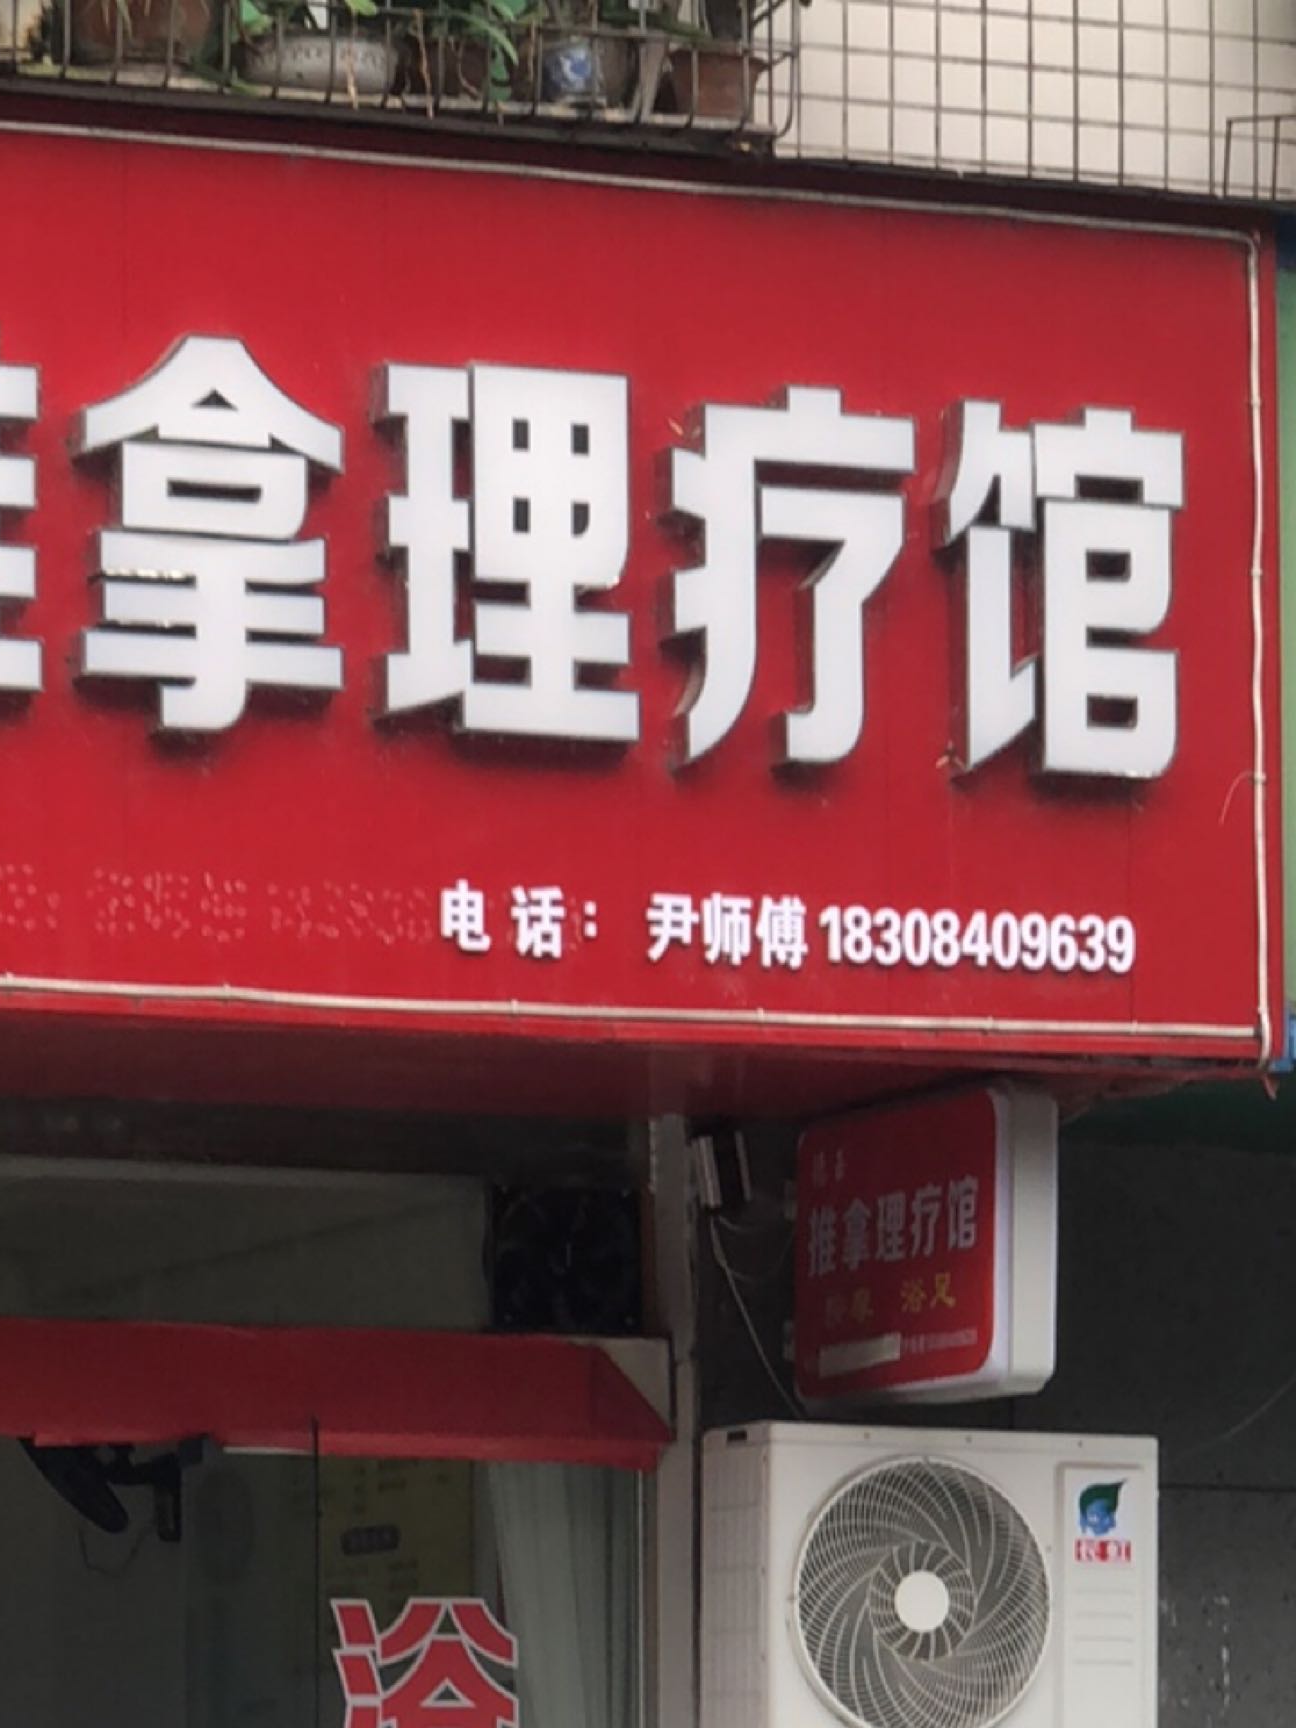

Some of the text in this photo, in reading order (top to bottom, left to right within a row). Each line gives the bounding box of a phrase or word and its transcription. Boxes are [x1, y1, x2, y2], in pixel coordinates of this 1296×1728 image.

[646, 892, 808, 970] 尹师傅
[819, 905, 1136, 974] 18308409639
[807, 1174, 979, 1278] 推拿理疗馆
